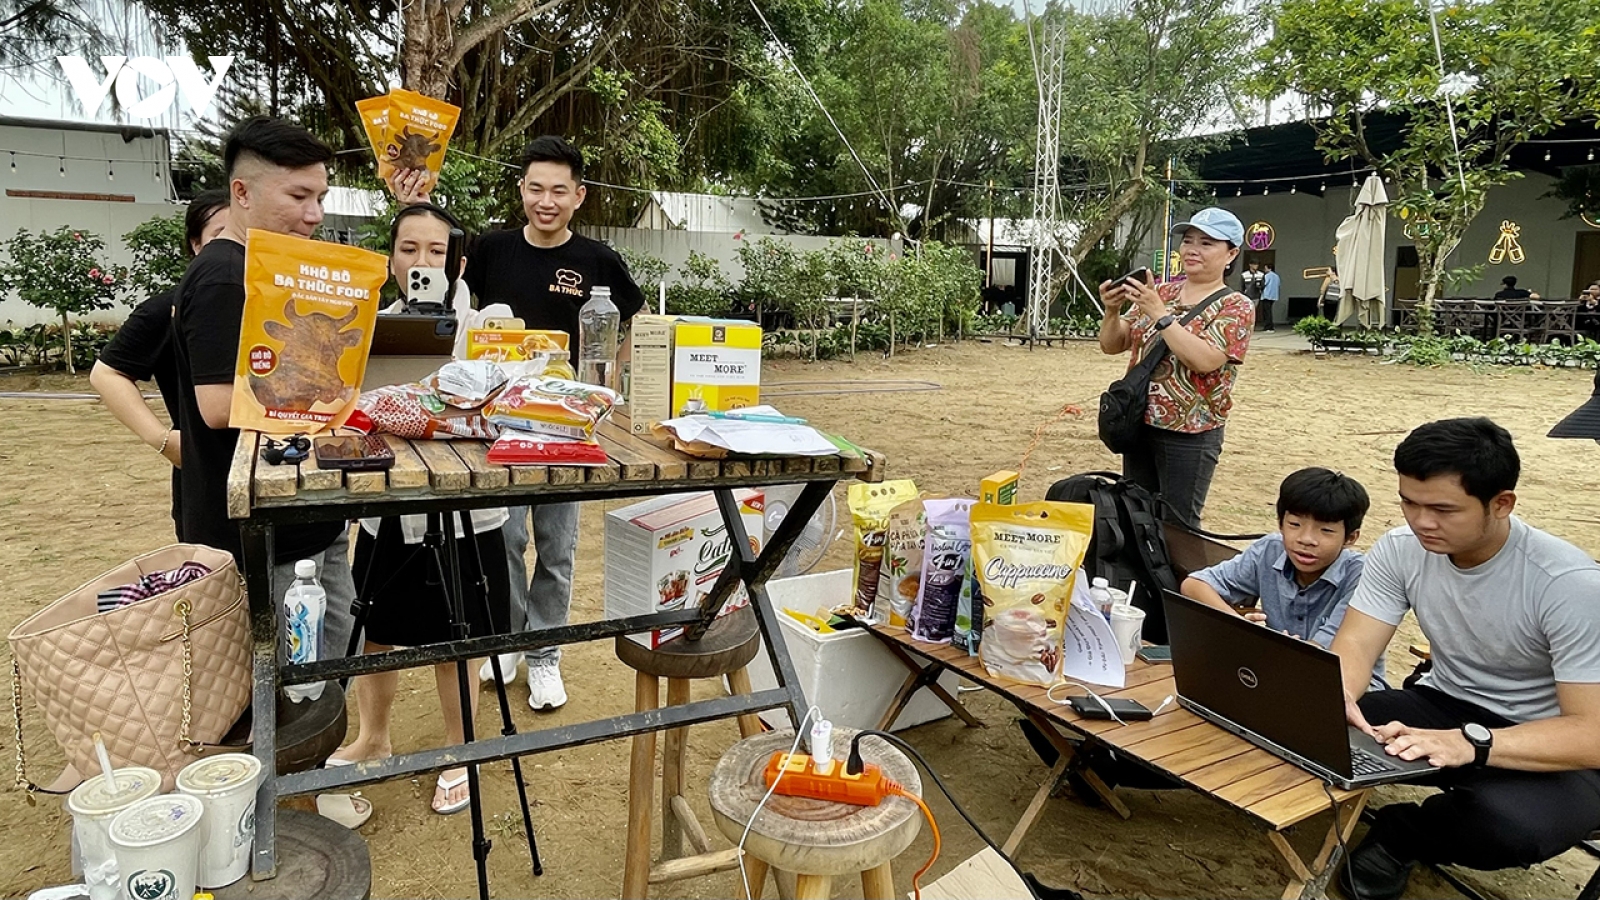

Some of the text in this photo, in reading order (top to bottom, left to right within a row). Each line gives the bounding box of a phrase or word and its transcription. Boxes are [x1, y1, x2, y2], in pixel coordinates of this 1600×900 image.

[299, 264, 350, 283] KHÔ BÒ
[274, 273, 295, 287] BA
[549, 284, 561, 293] BA
[689, 353, 719, 363] MEET
[714, 364, 745, 374] MORE
[993, 532, 1061, 544] MEET MORE
[984, 555, 1073, 588] Cappuccino
